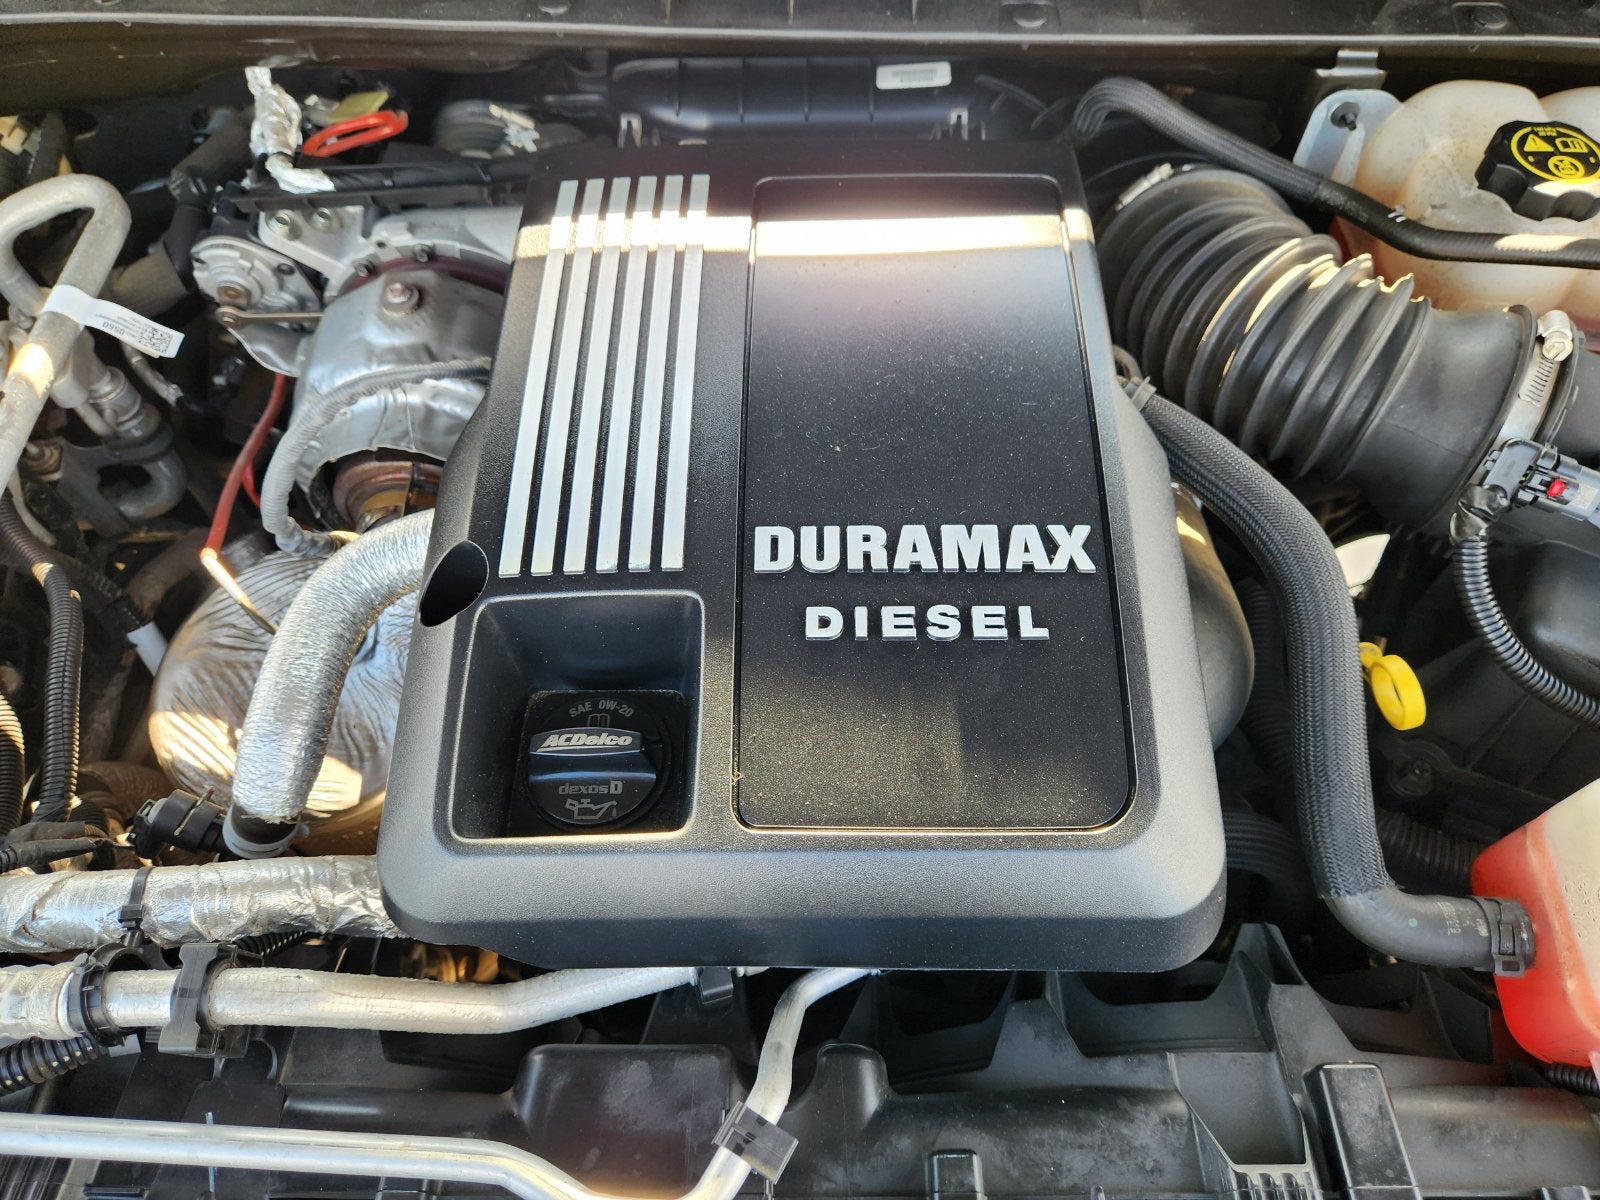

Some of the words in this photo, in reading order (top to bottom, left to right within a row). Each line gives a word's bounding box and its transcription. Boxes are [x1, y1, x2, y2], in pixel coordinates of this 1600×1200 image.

[754, 524, 1097, 573] DURAMAX
[805, 604, 1050, 641] DIESEL
[569, 702, 593, 718] SAE
[598, 700, 635, 718] 0W-20
[540, 732, 633, 747] ACDelco
[558, 780, 623, 795] dexosD
